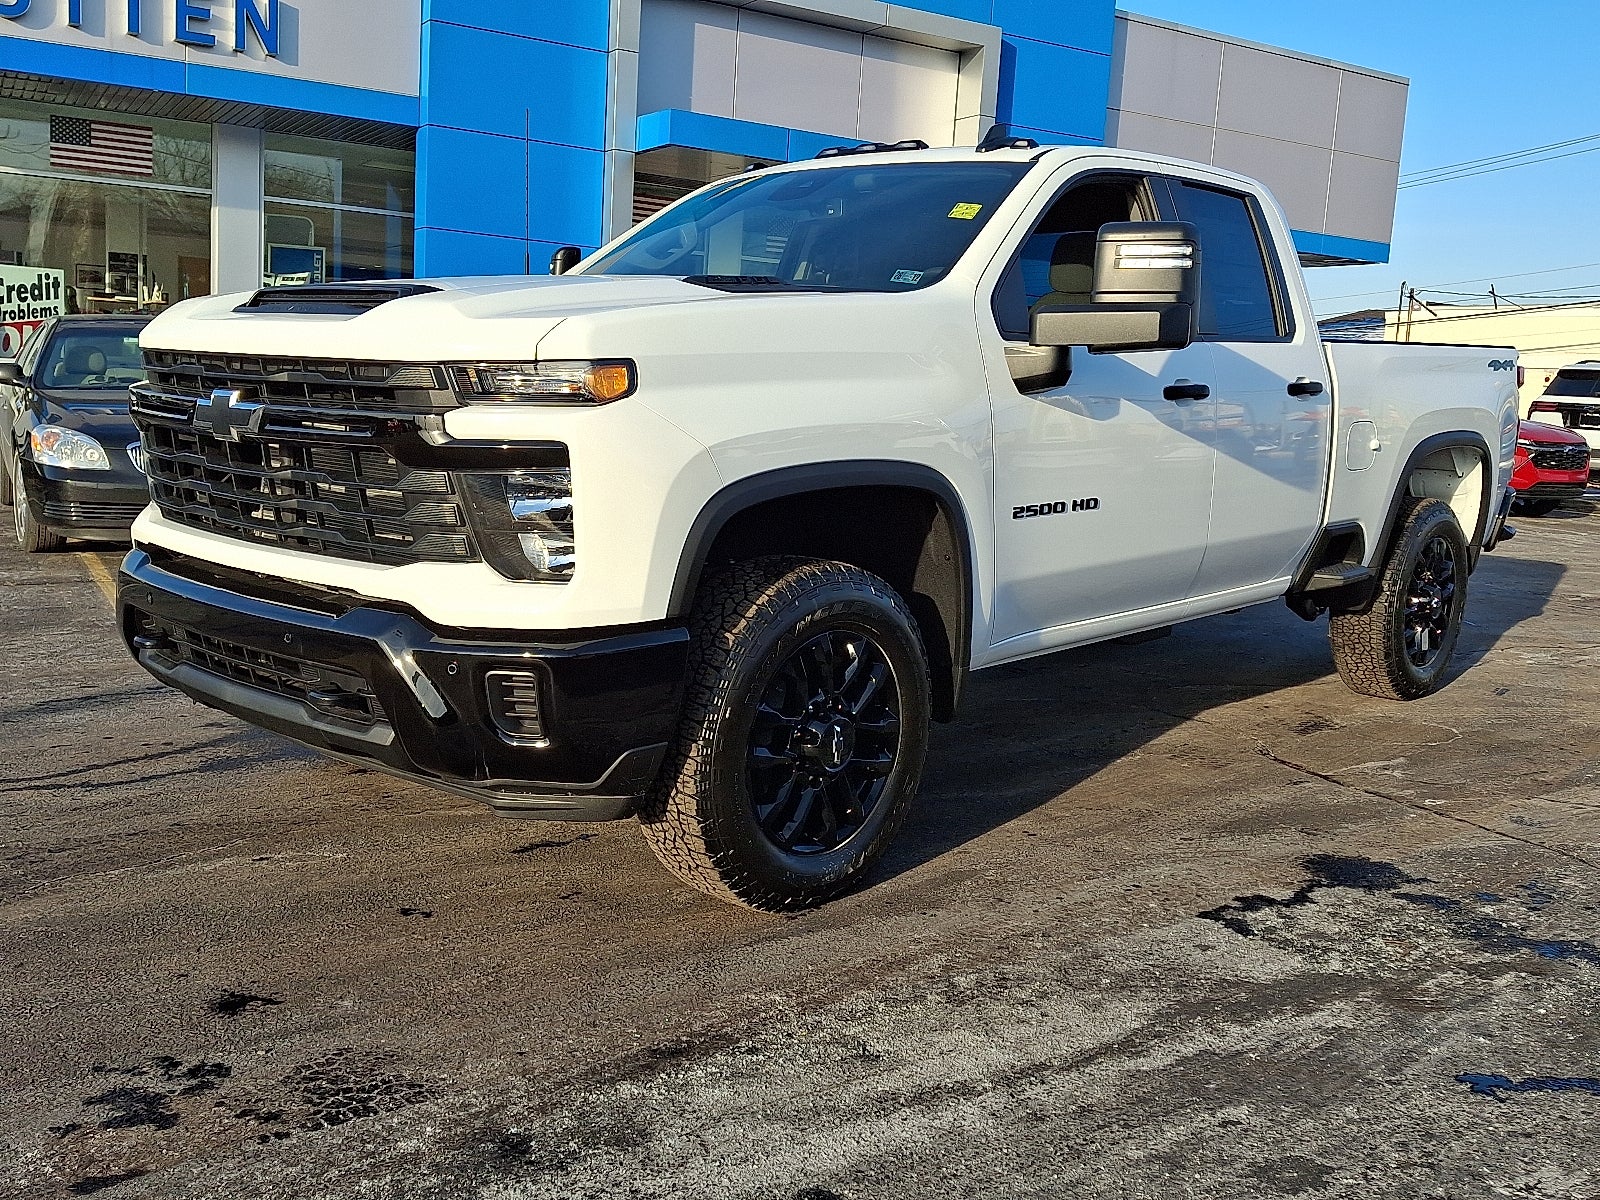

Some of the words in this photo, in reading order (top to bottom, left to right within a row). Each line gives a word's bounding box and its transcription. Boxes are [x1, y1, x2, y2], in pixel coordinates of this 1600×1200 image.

[0, 302, 59, 321] roblems
[1012, 500, 1068, 520] 2500
[1071, 497, 1099, 513] HD
